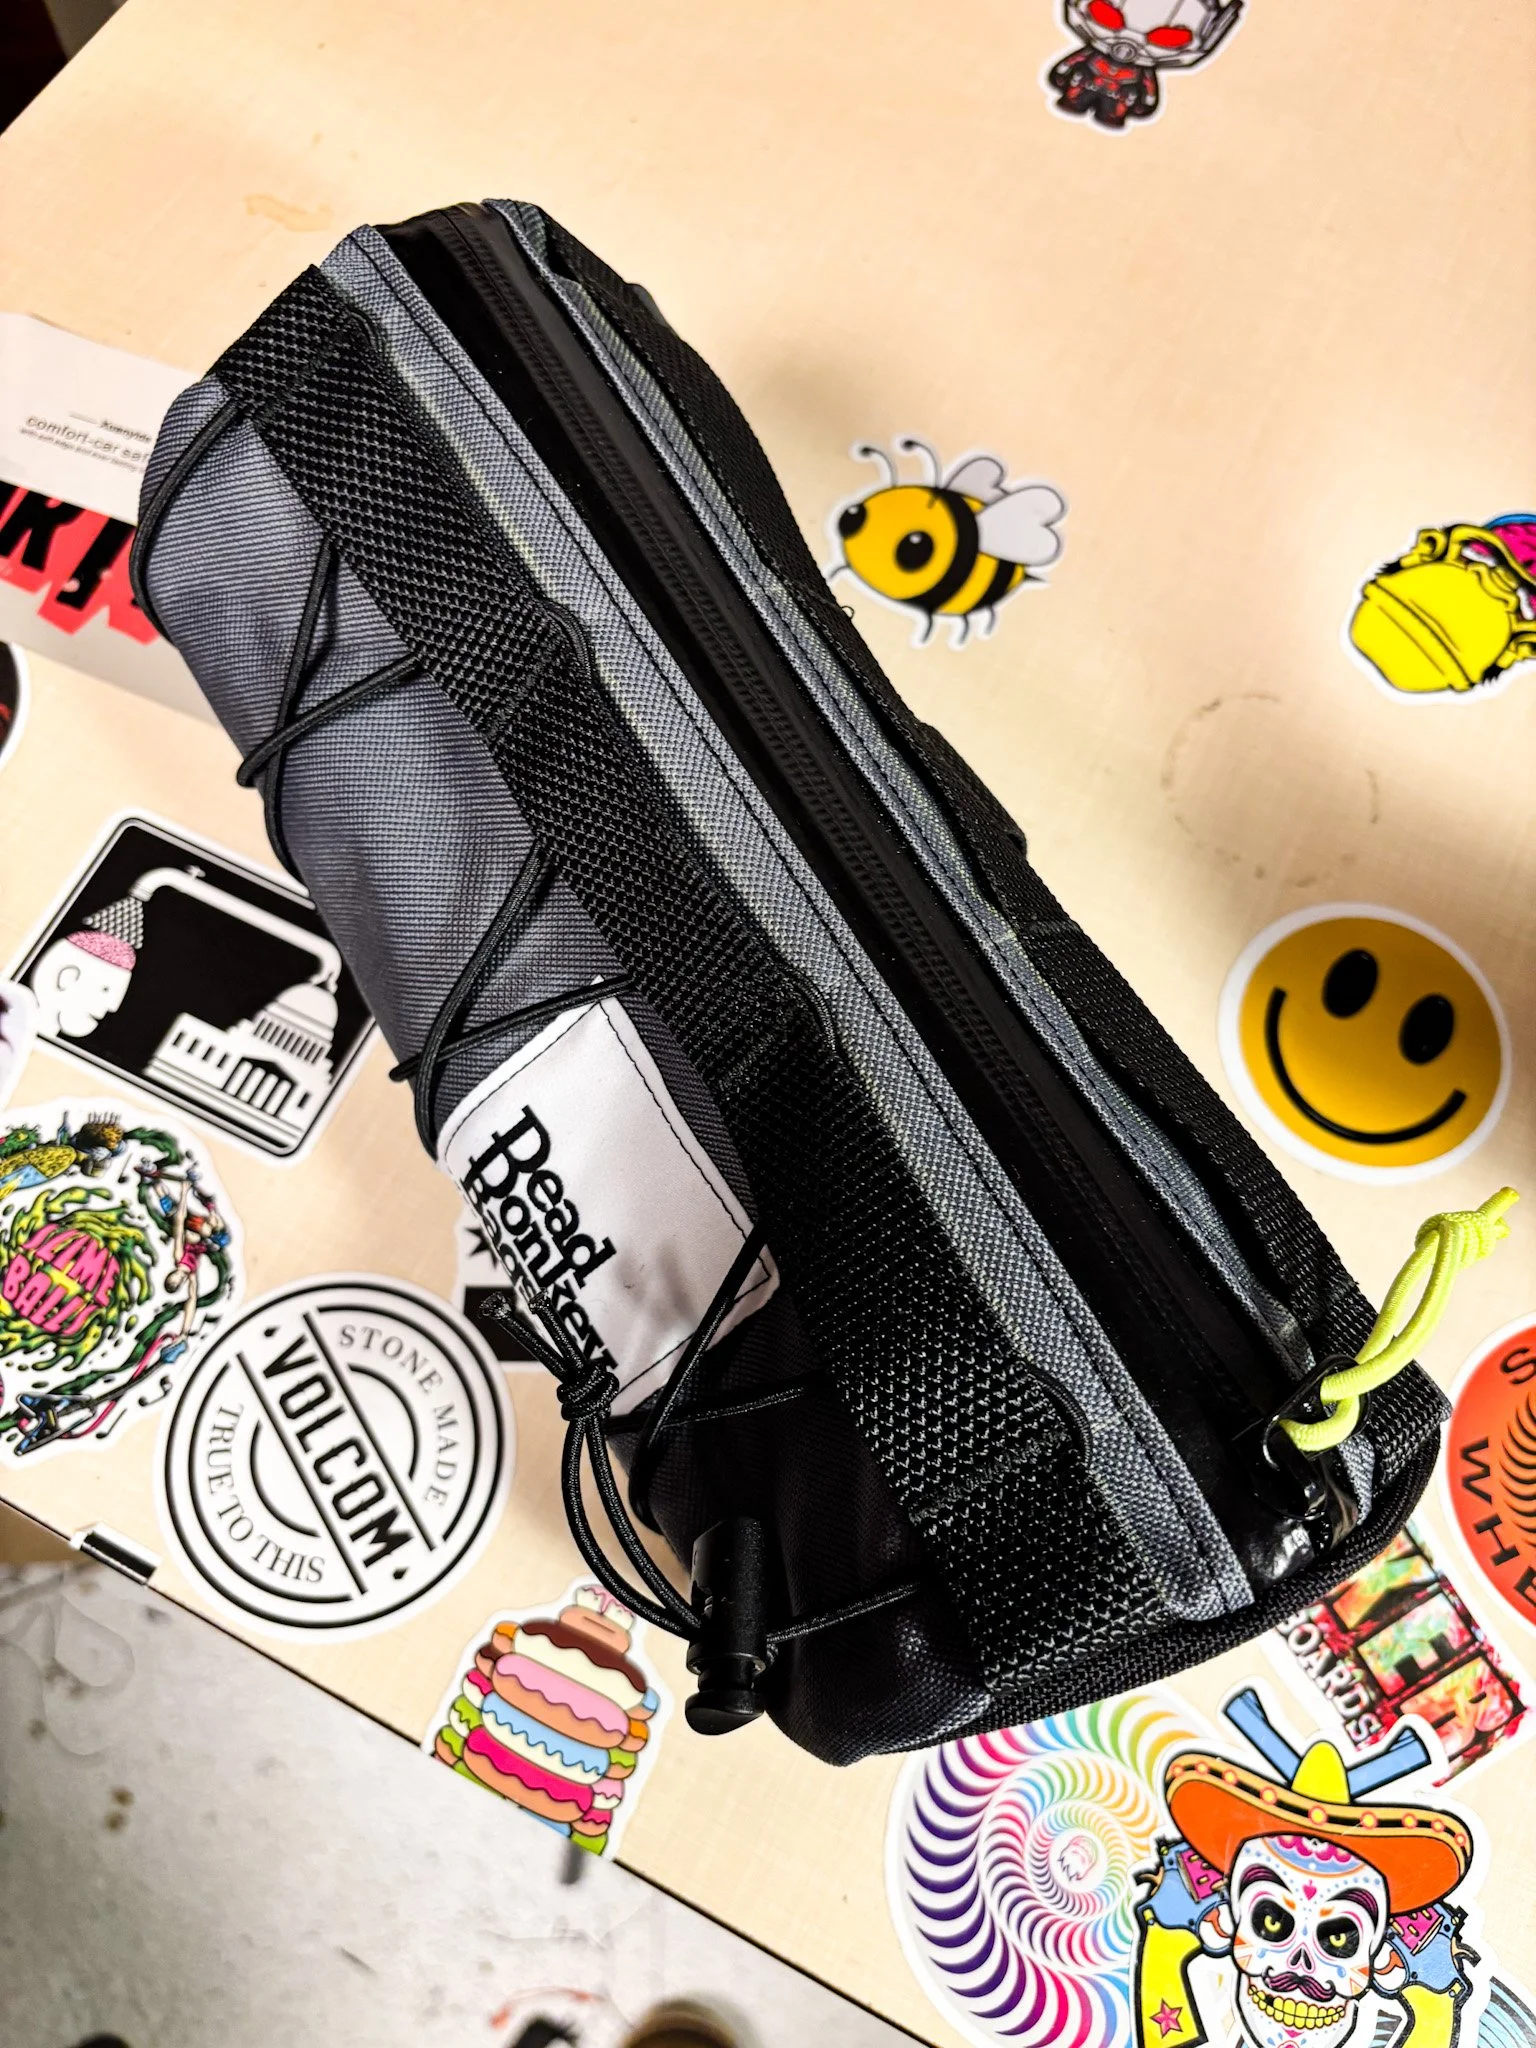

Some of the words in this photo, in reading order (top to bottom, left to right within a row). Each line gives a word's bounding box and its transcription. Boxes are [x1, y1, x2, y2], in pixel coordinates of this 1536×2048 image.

[493, 1104, 617, 1289] Dead
[3, 1253, 99, 1335] BALLS
[21, 1223, 121, 1307] SLIME
[207, 1403, 245, 1495] TRUE
[262, 1333, 415, 1569] VOLCOM
[338, 1323, 443, 1395] STONE
[424, 1403, 460, 1507] MADE
[216, 1495, 254, 1543] TO
[250, 1533, 327, 1584] THIS
